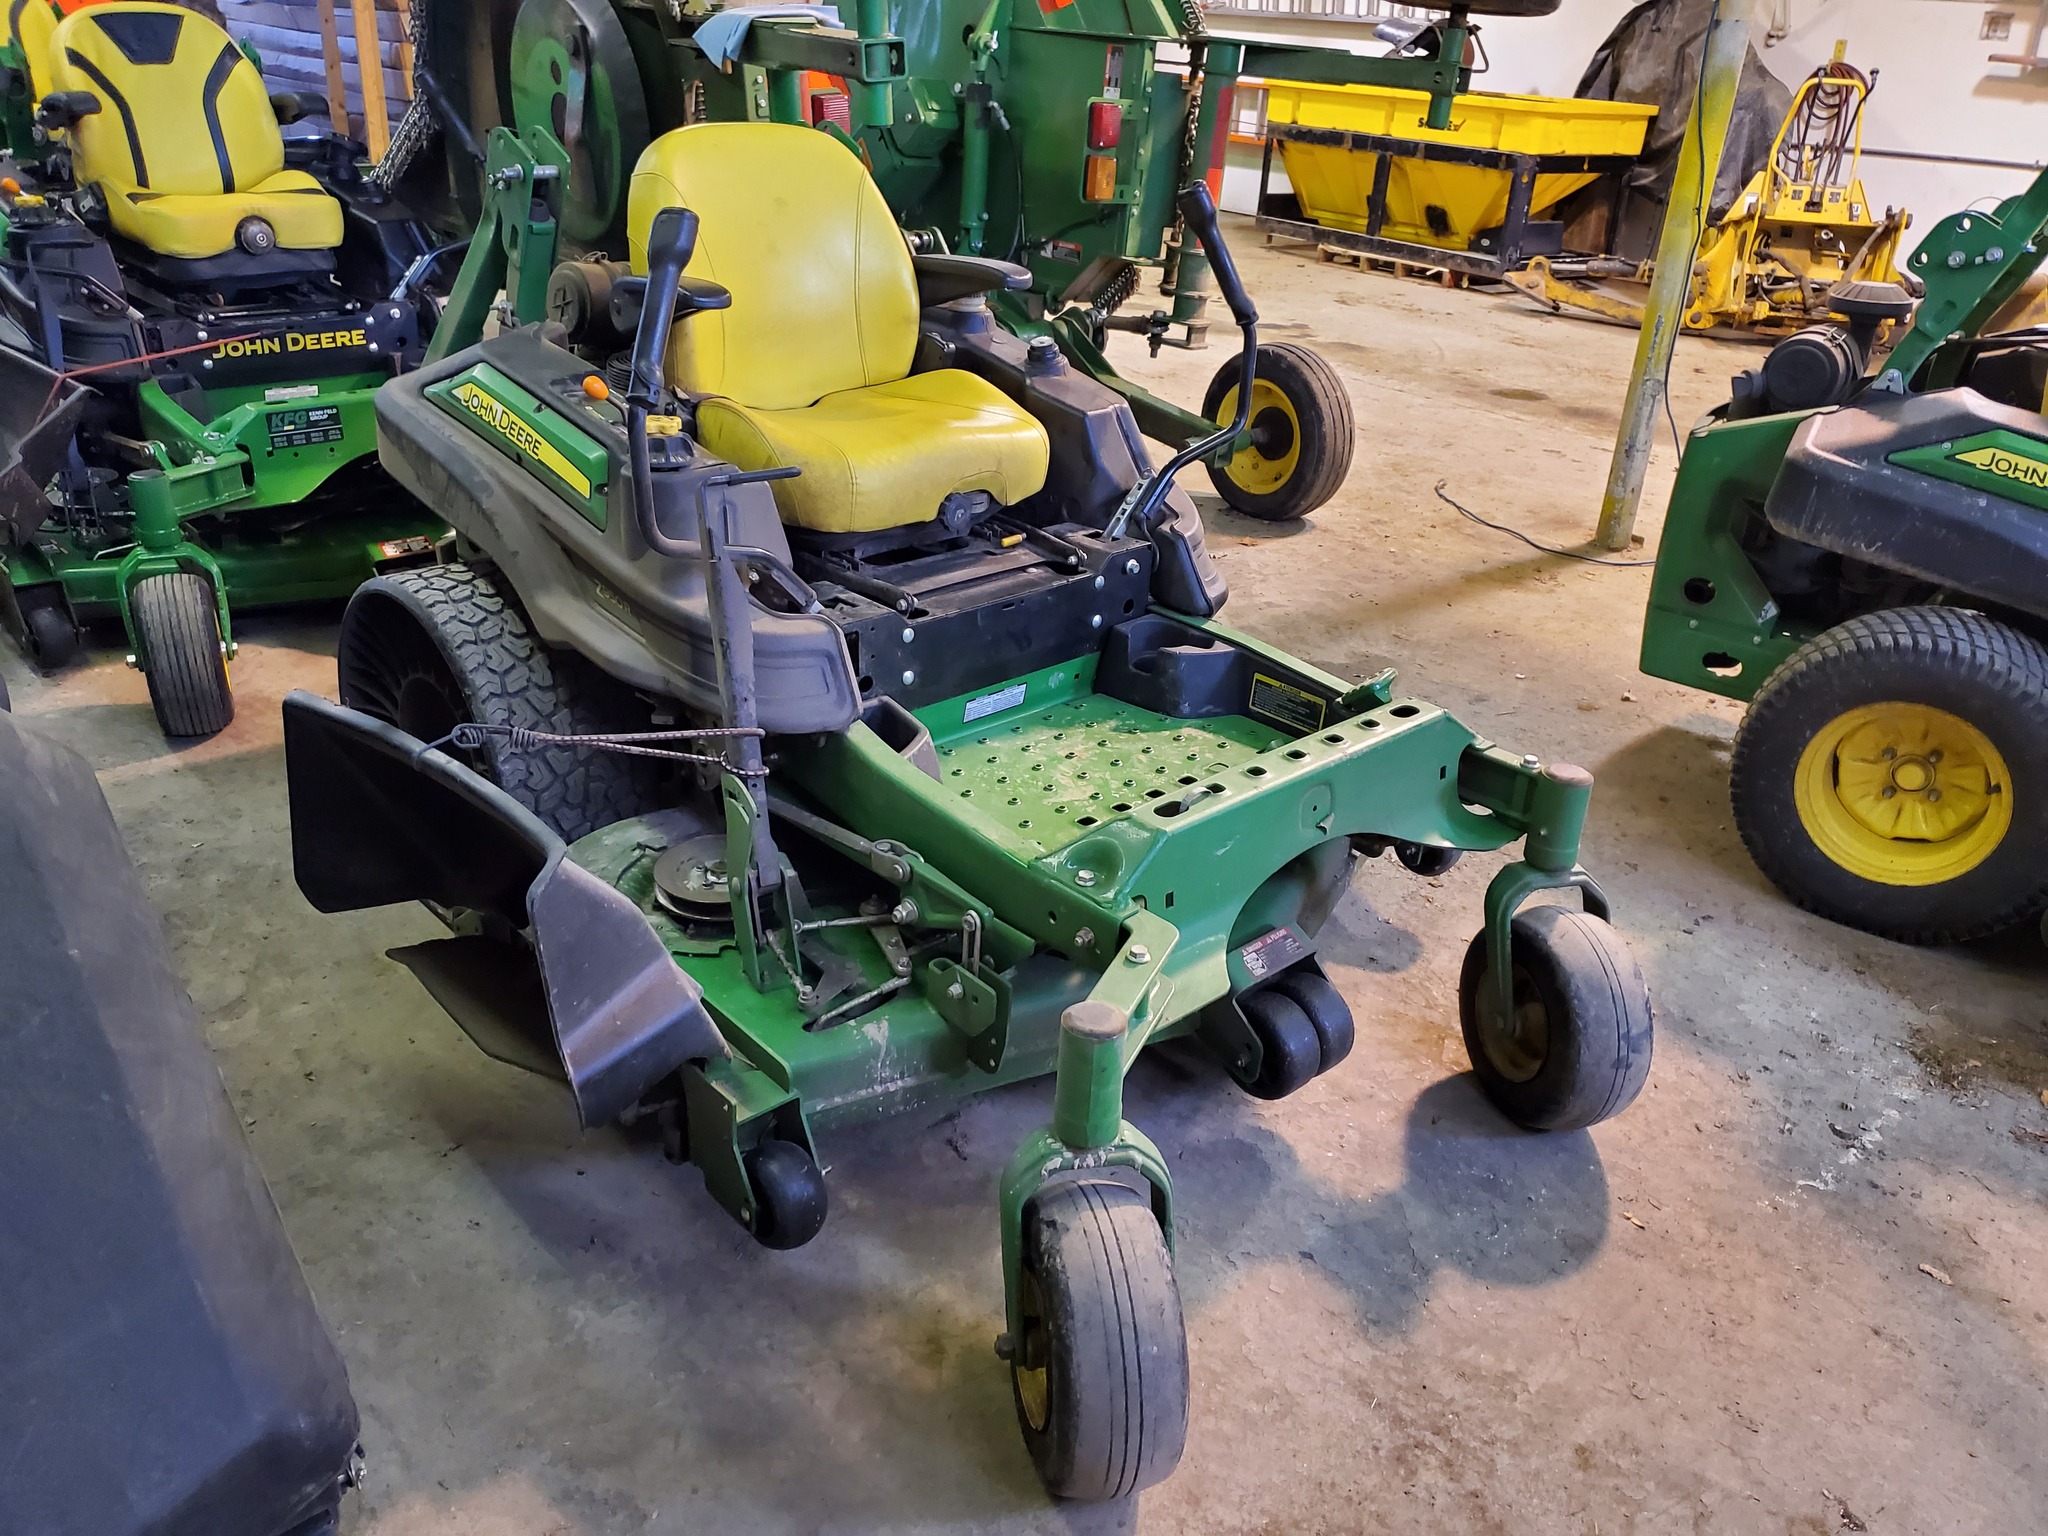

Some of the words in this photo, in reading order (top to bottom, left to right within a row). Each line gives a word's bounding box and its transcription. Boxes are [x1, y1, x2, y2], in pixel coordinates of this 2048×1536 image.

[212, 337, 281, 359] JOHN
[286, 329, 367, 352] DEERE
[271, 410, 308, 428] KFG
[463, 387, 499, 423] JOHN
[499, 411, 542, 457] DEERE
[1979, 452, 2048, 484] JOHN
